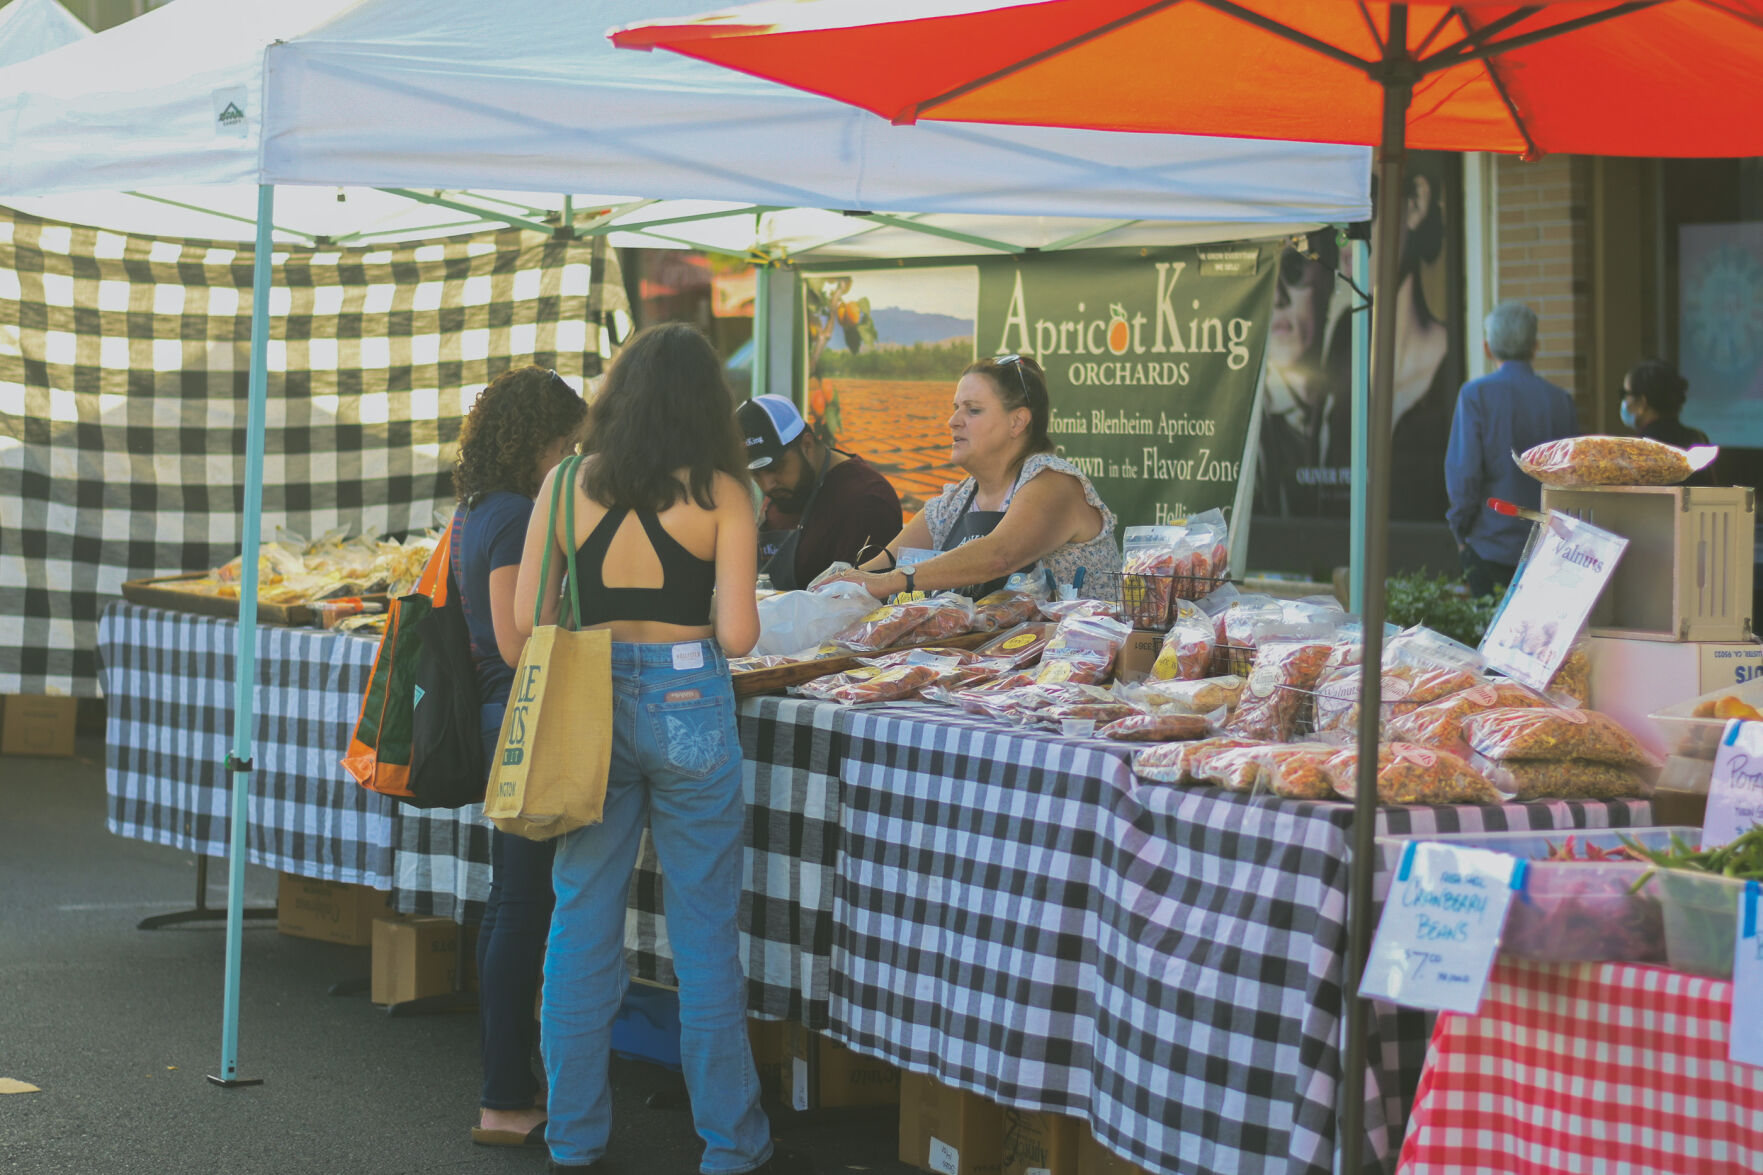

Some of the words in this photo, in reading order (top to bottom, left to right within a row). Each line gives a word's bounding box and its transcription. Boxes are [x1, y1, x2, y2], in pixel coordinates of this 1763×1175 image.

[995, 268, 1147, 370] Apricot
[1151, 262, 1252, 370] King
[1068, 362, 1190, 385] ORCHARDS
[1091, 409, 1154, 435] Blenheim
[1157, 411, 1215, 443] Apricots
[1109, 459, 1119, 478] in
[1121, 457, 1138, 479] the
[1142, 446, 1195, 480] Flavor
[1416, 914, 1468, 942] BEANS
